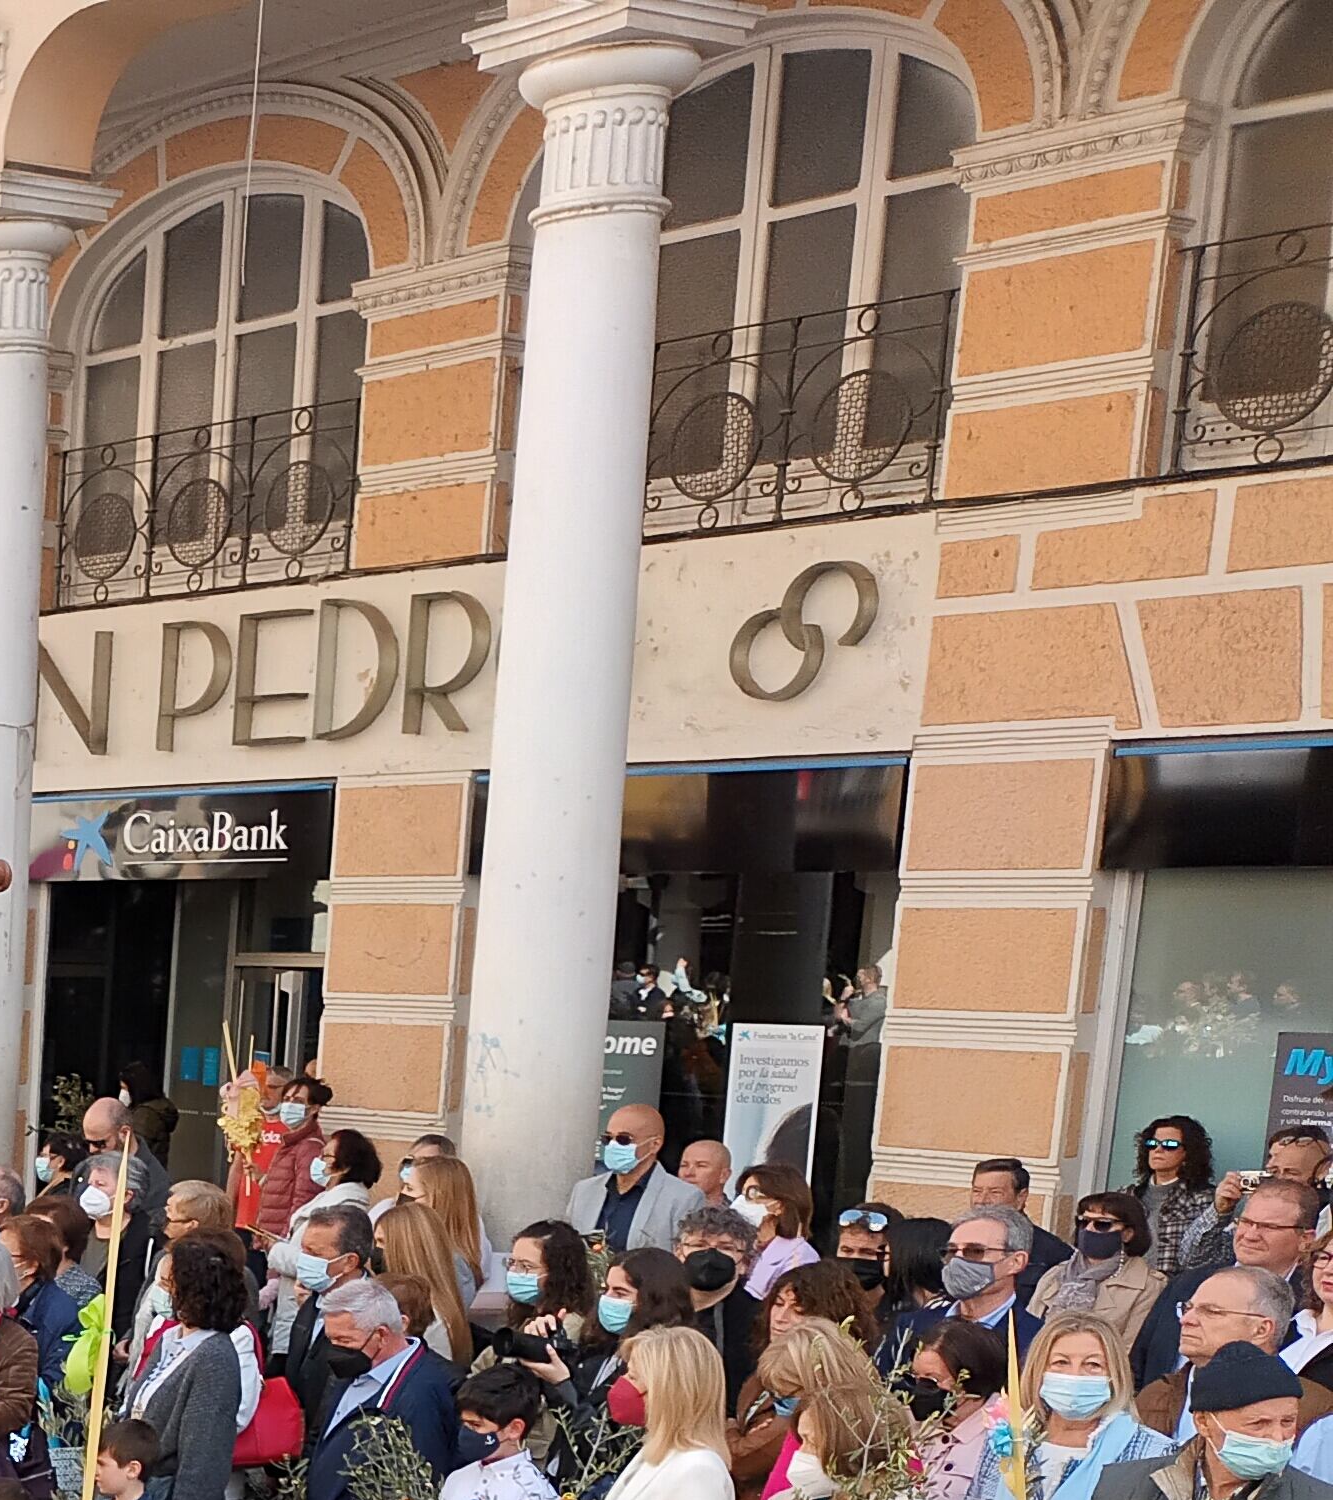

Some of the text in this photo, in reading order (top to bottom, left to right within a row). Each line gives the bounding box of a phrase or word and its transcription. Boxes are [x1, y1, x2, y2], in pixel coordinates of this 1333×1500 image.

[156, 590, 501, 752] PEDR
[123, 809, 289, 853] CaixaBank
[739, 1054, 810, 1068] Investigamos
[738, 1069, 757, 1079] por
[759, 1067, 769, 1078] la
[736, 1092, 781, 1104] de todos
[1301, 1117, 1332, 1126] alarma
